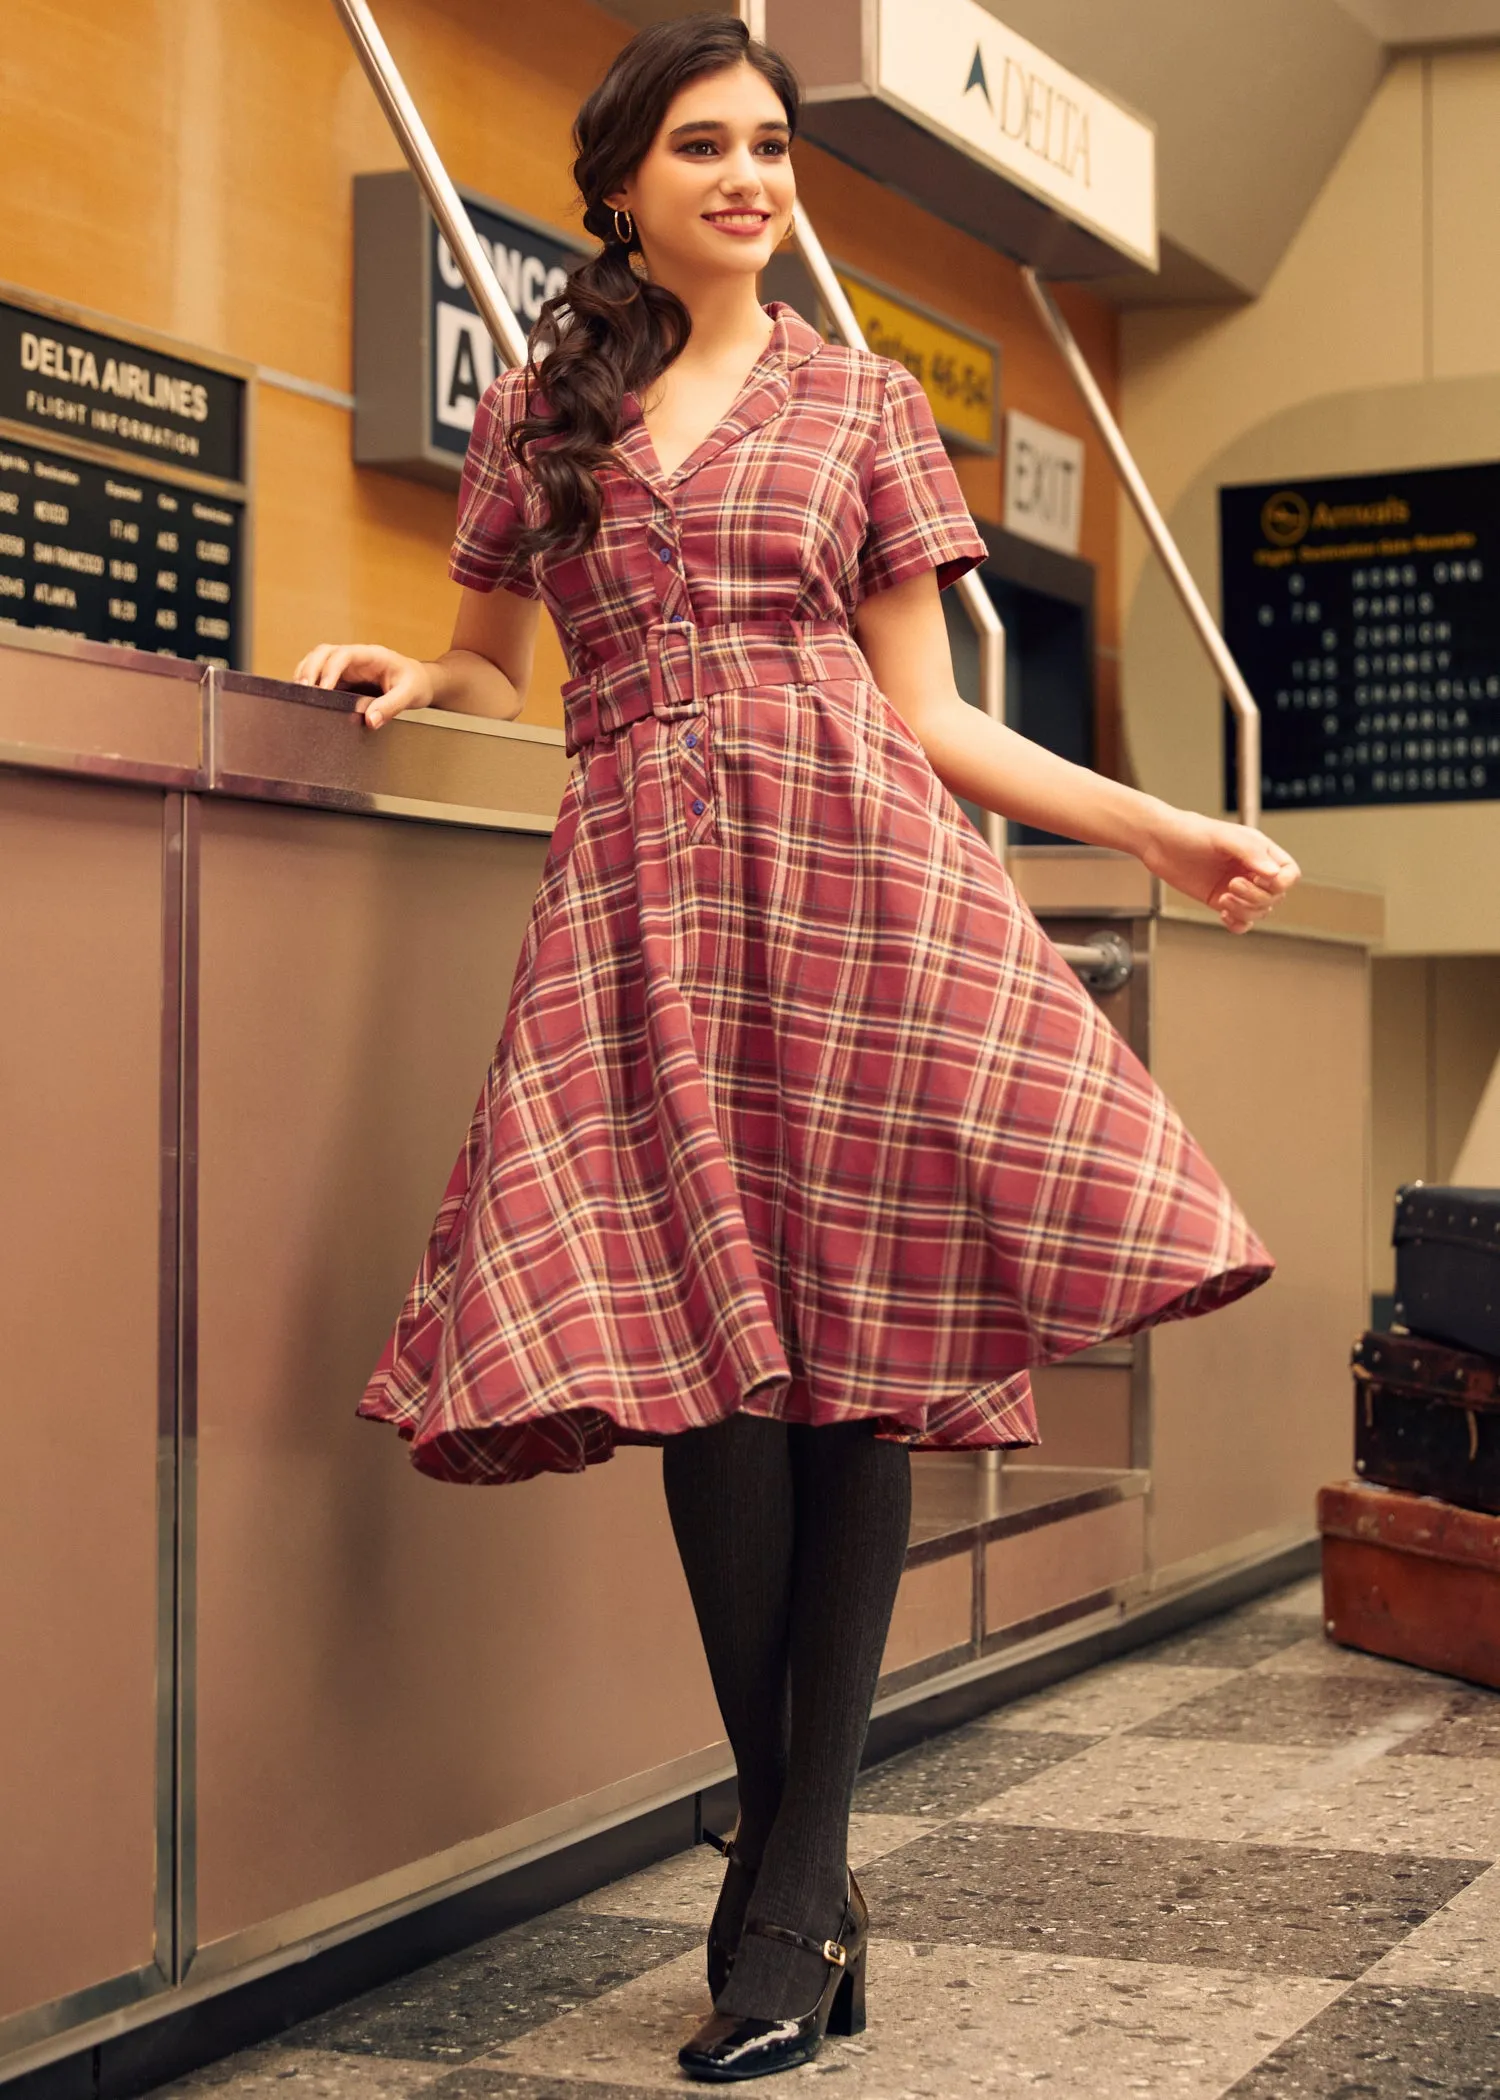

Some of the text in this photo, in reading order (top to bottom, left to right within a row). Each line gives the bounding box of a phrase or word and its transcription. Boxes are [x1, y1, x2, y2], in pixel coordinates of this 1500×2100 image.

[1000, 55, 1092, 190] DELTA
[21, 331, 209, 422] DELTA AIRLINES
[26, 389, 200, 457] FLIGHT INFORMATION
[1015, 437, 1076, 532] EXIT
[1352, 592, 1434, 618] PARIS
